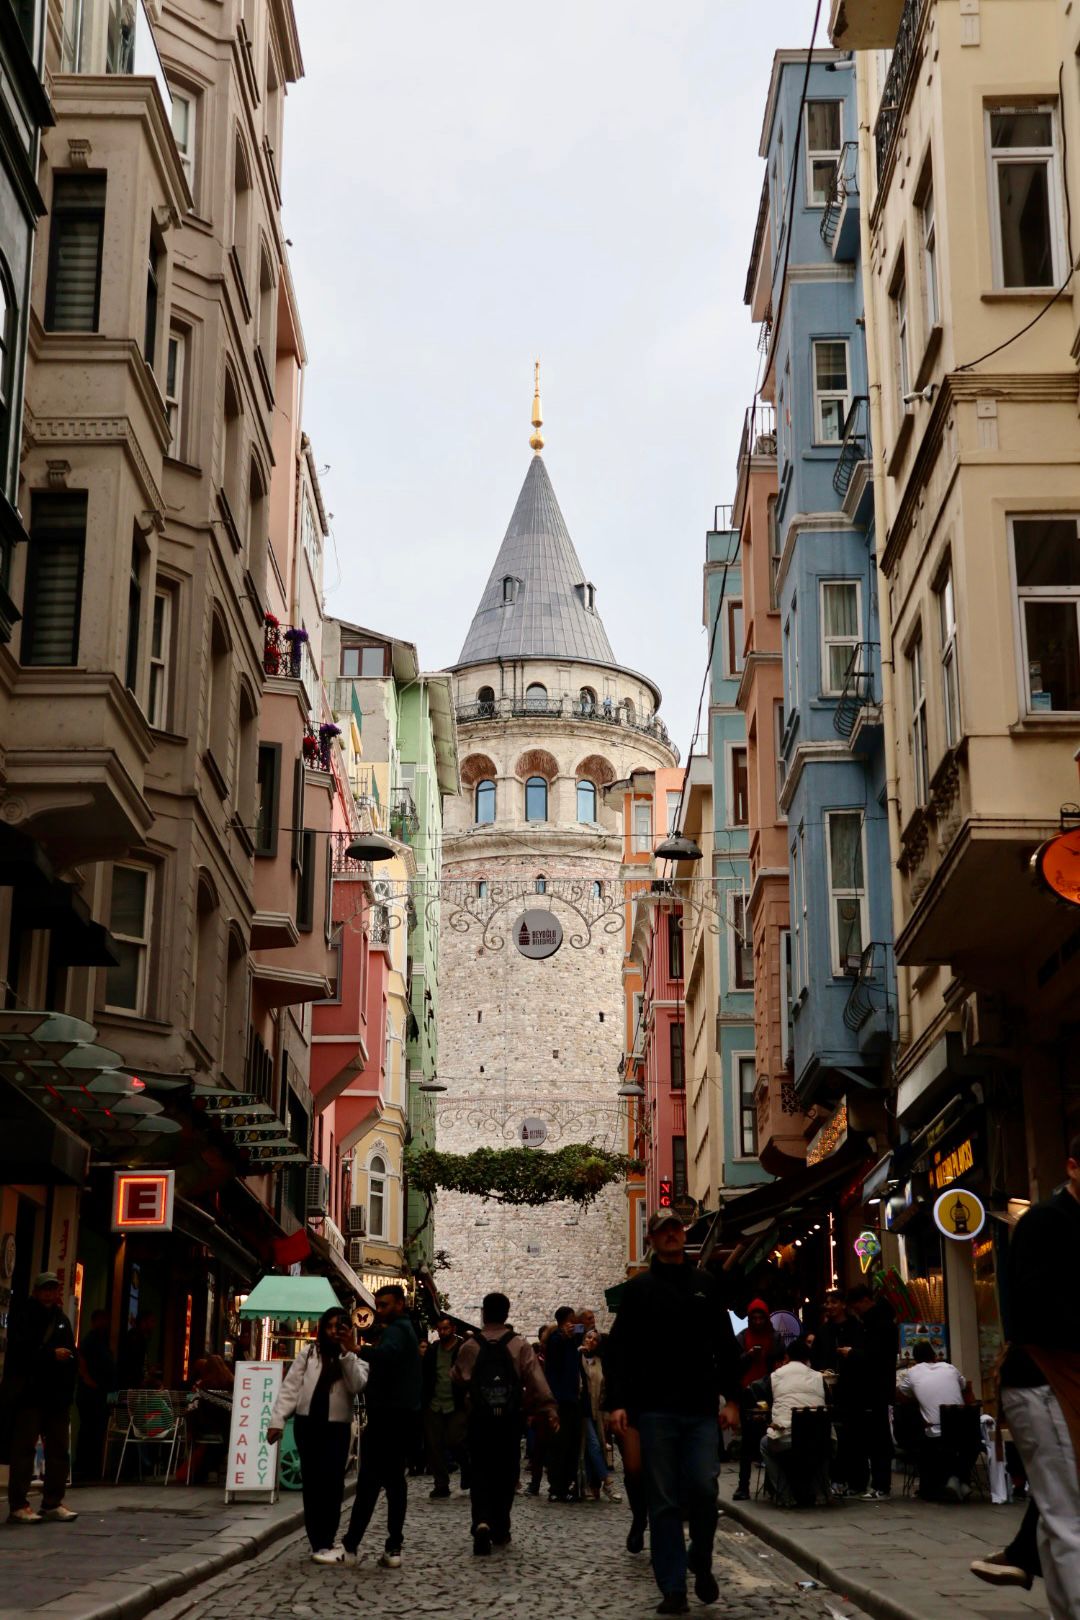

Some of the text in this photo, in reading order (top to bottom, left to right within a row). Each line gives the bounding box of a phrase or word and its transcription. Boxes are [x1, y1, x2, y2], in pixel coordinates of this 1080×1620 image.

[128, 1183, 157, 1218] E
[235, 1378, 252, 1484] ECZANE
[257, 1378, 273, 1485] PHARMACY
